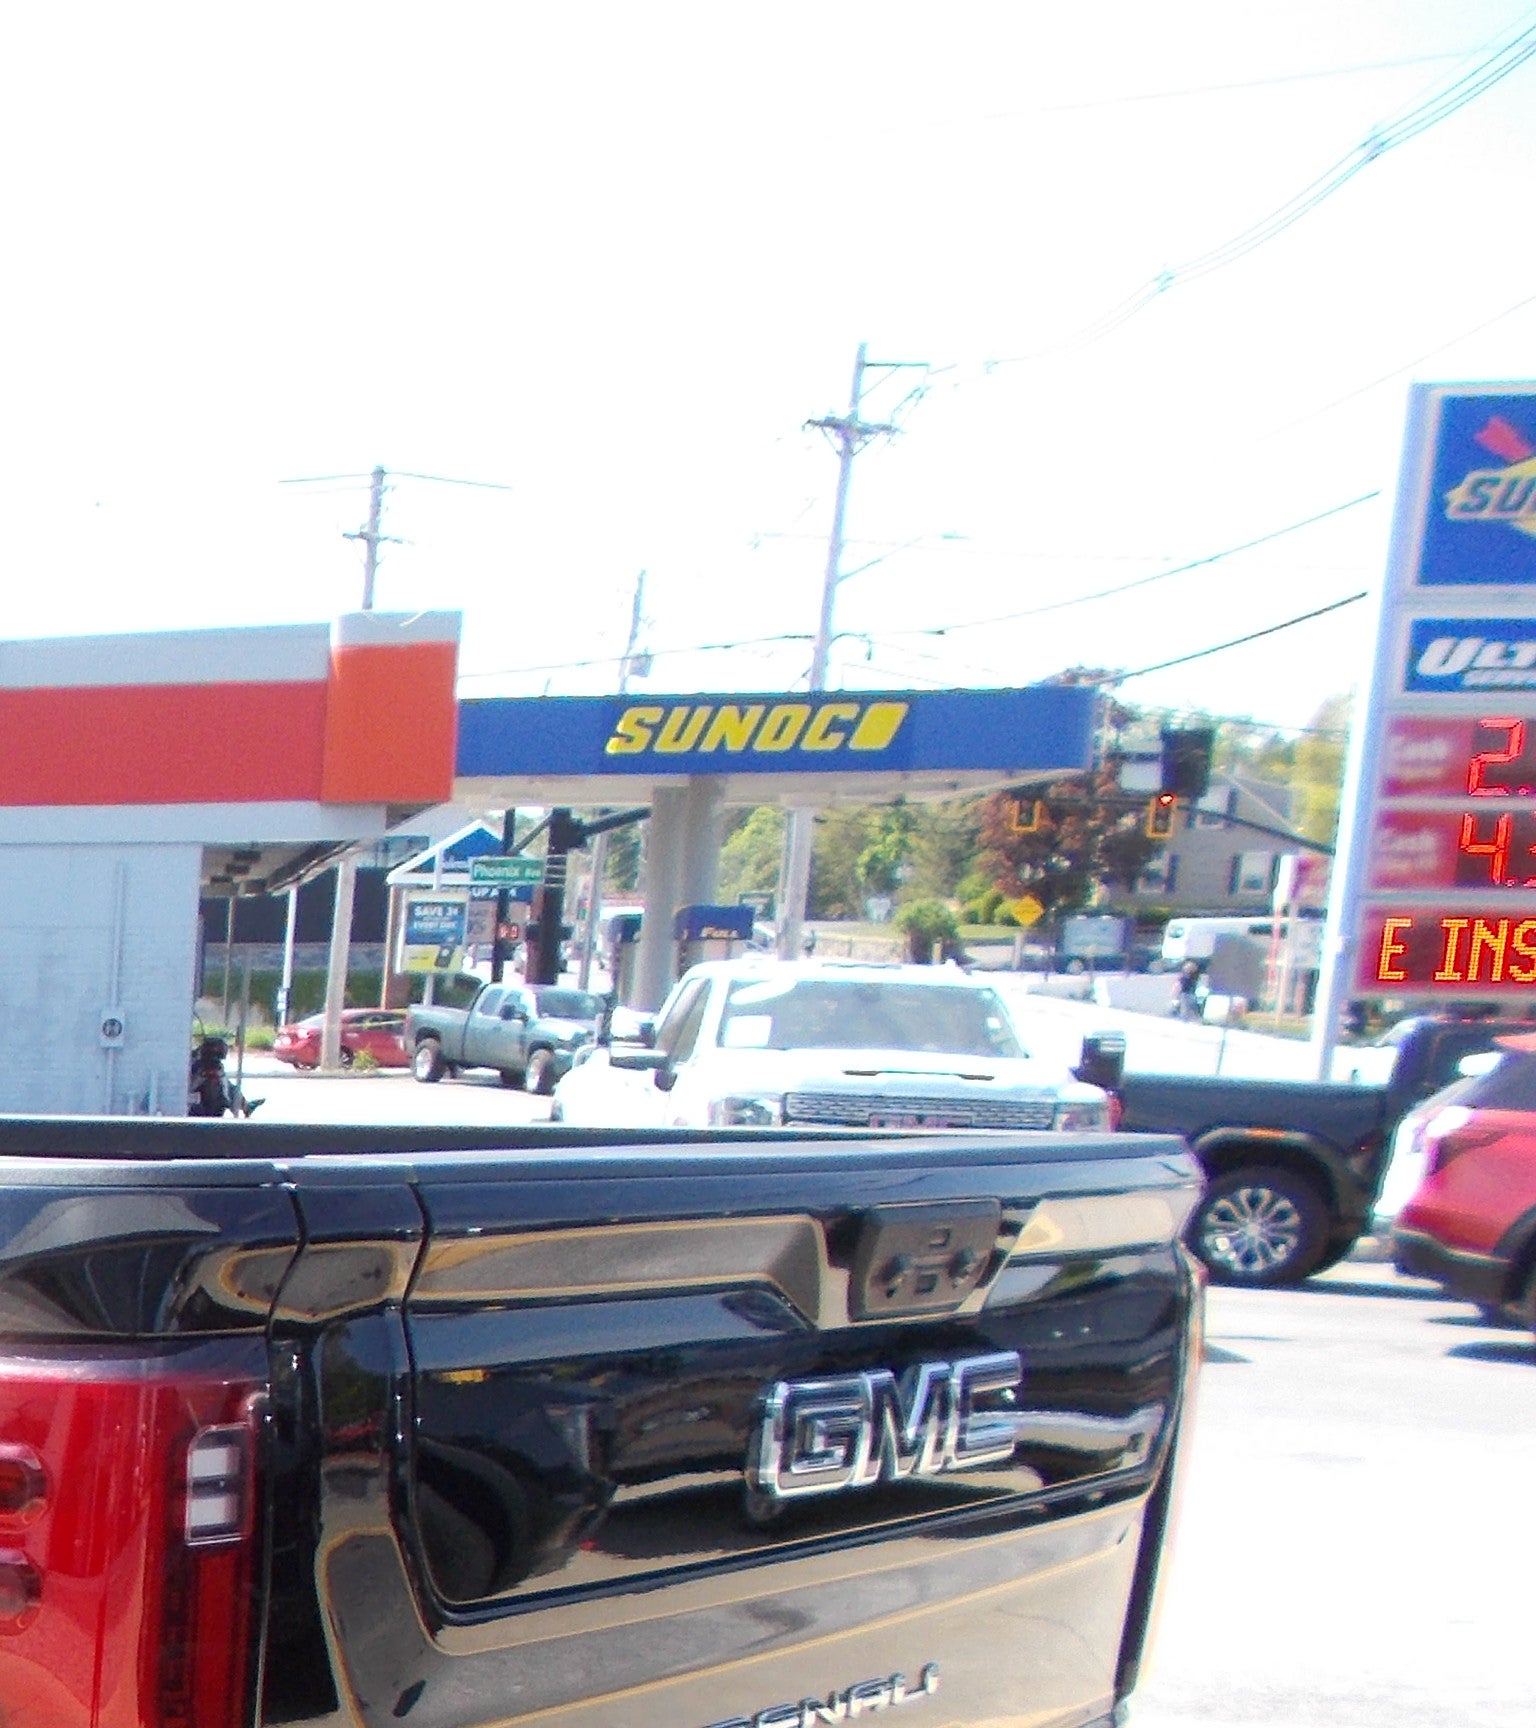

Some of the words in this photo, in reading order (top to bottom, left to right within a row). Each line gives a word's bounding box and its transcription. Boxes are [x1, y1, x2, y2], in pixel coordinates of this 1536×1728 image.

[606, 702, 909, 753] SUNOCO
[1379, 918, 1412, 981] E
[762, 1350, 1020, 1499] GMC
